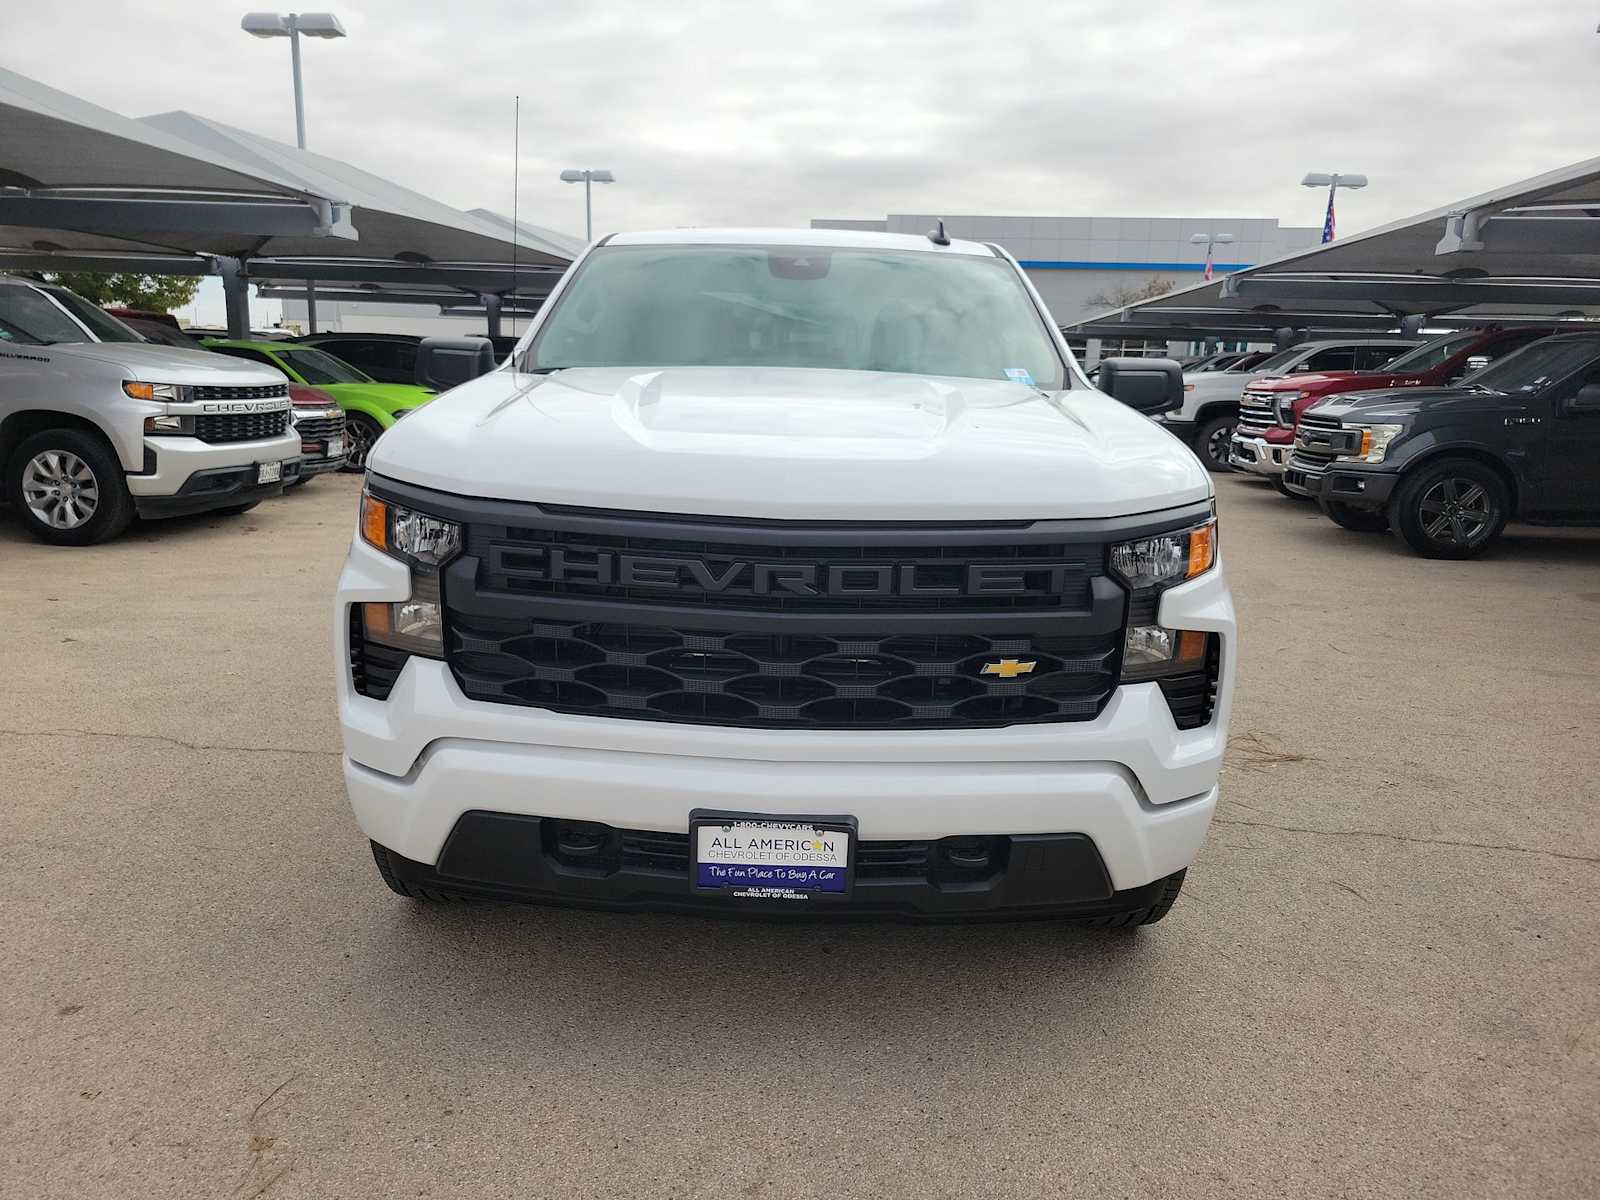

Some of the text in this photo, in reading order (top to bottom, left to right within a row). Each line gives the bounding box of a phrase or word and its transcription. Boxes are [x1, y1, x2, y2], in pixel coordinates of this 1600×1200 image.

[488, 543, 1087, 596] CHEVROLET
[734, 821, 814, 832] 1-800-CHEVYCARS
[711, 837, 834, 852] ALL AMERICN
[708, 849, 837, 863] CHEVROLET OF ODESSA
[708, 866, 836, 882] The Fun Place To Buy A Car
